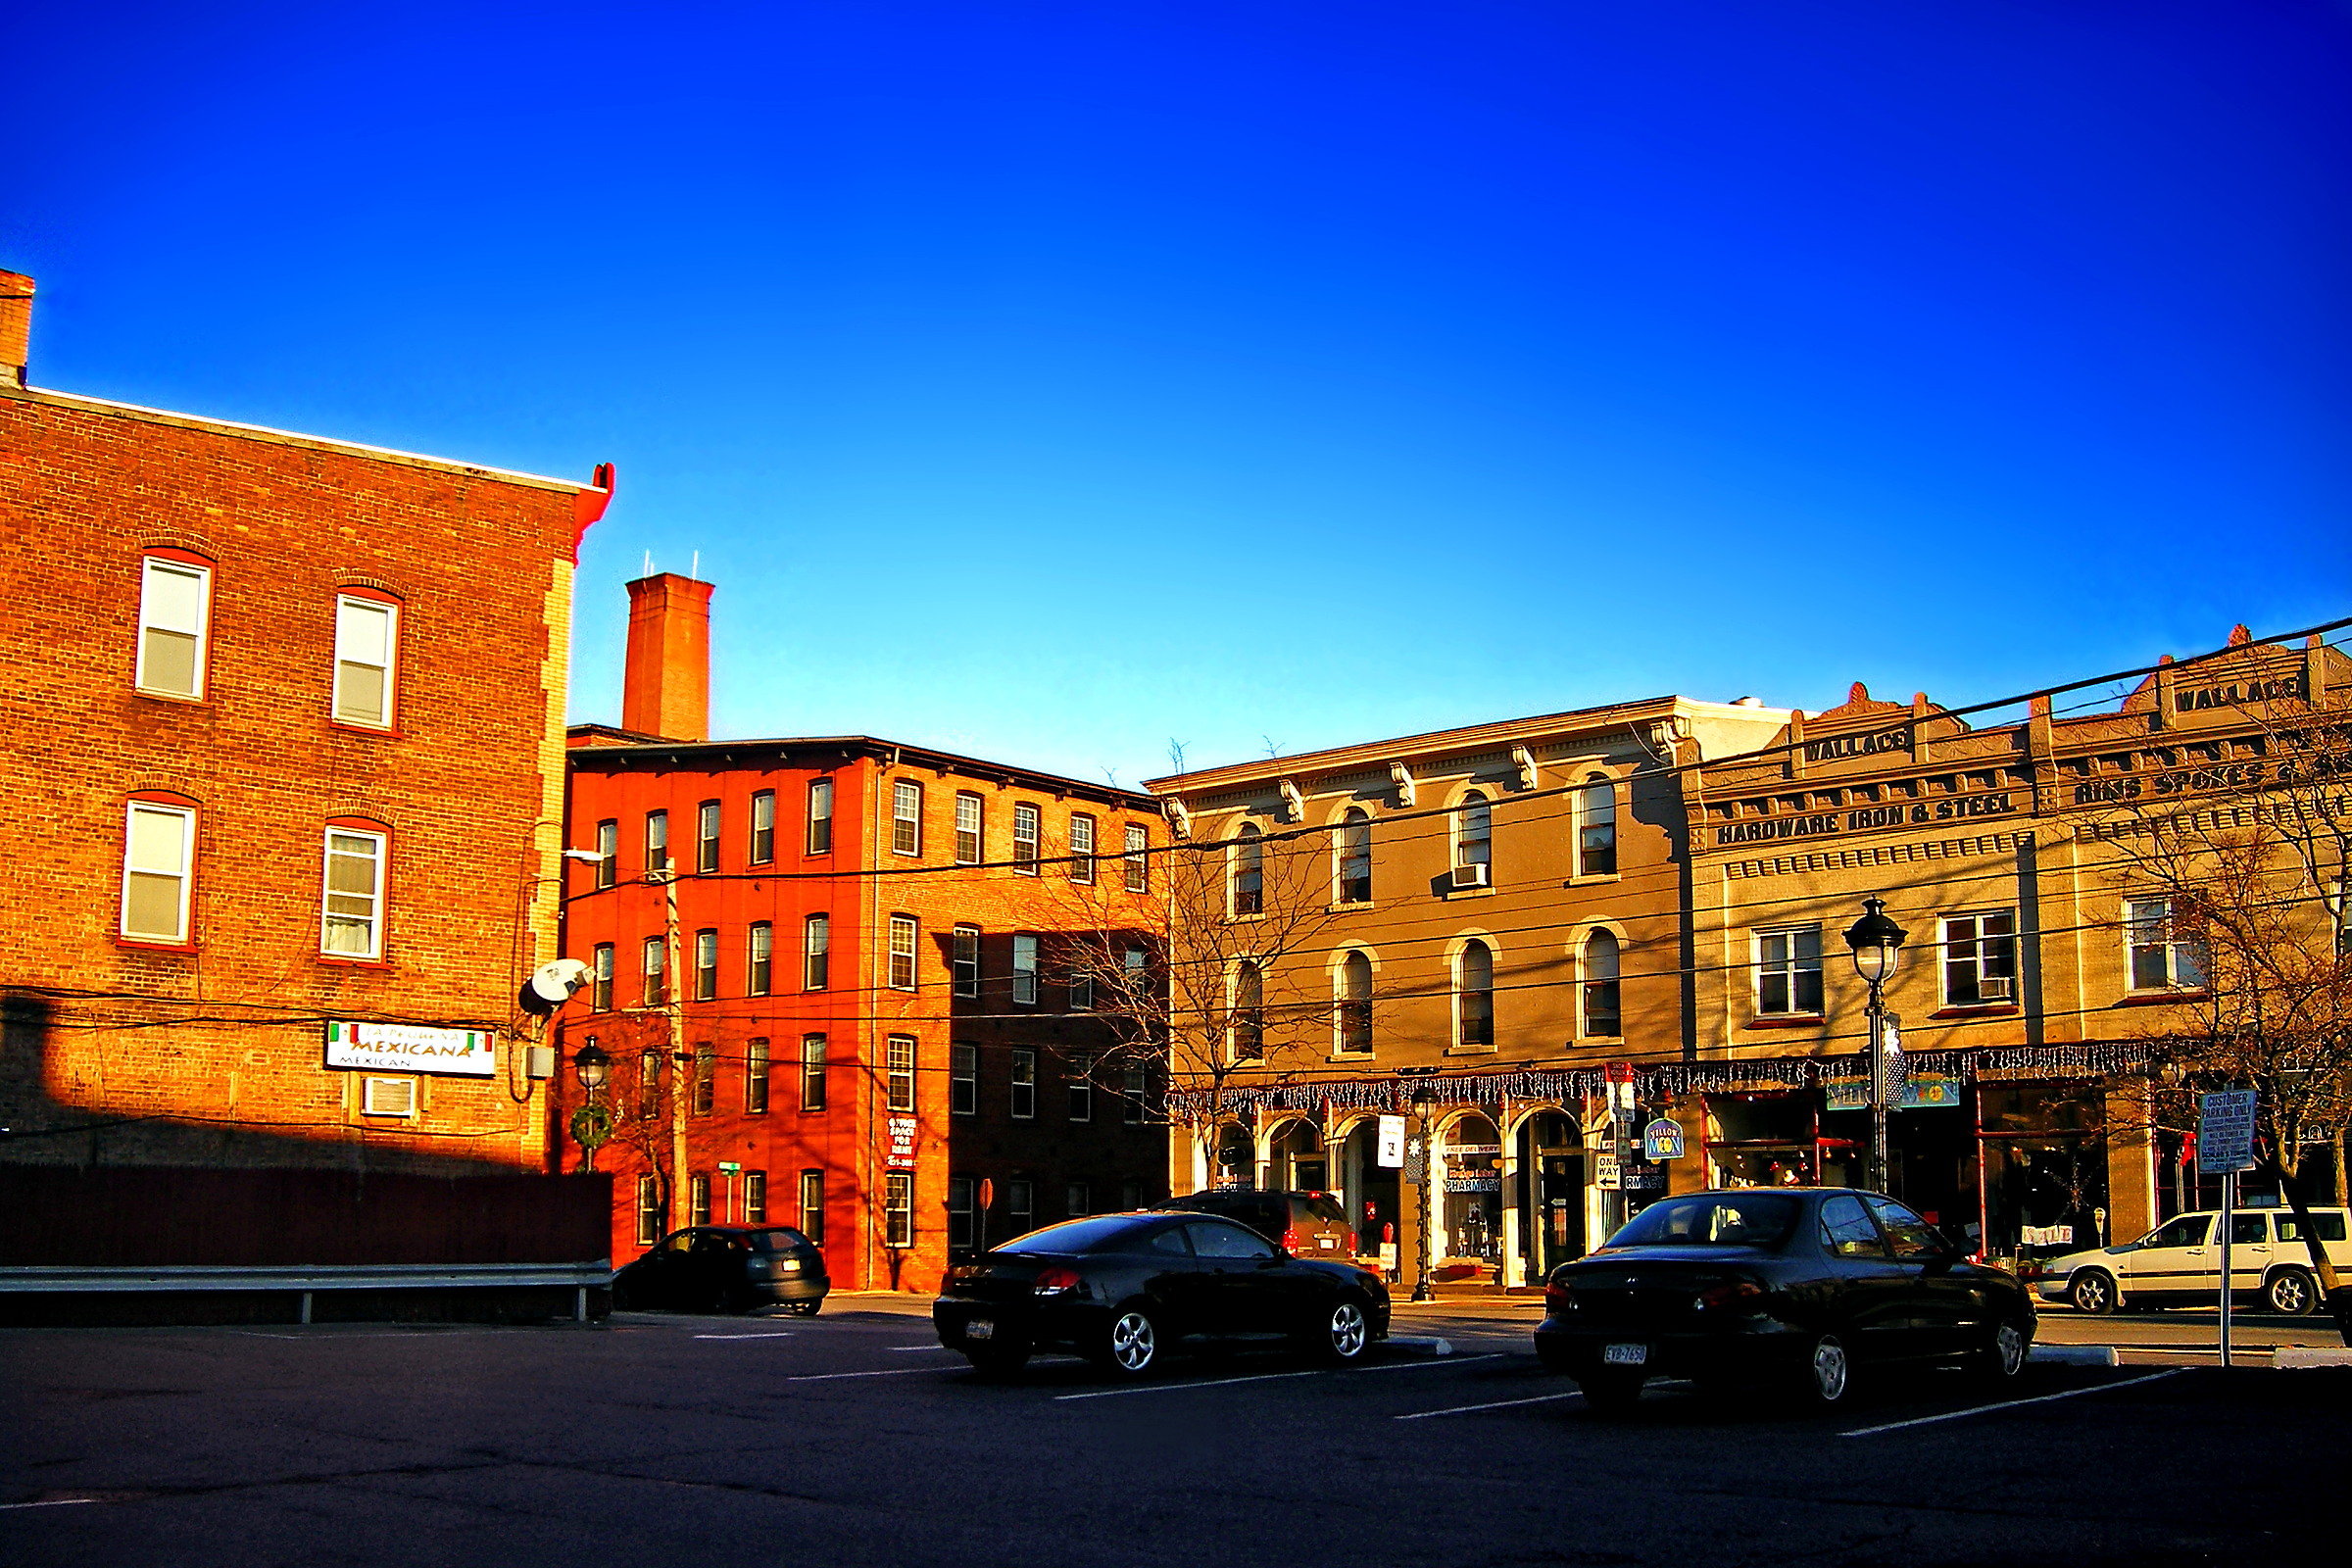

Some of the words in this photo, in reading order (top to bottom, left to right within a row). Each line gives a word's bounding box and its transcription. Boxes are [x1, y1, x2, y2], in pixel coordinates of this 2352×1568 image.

[2176, 678, 2299, 712] WALLACE
[1804, 730, 1911, 761] WALLACE
[1717, 812, 1841, 845] HARDWARE
[1847, 805, 1906, 831] IRON
[1911, 804, 1931, 823] &
[1936, 793, 2019, 819] STEEL
[351, 1041, 471, 1058] MEXICANA
[339, 1056, 411, 1067] MEXICAN
[2207, 1092, 2248, 1107] CUSTOMER
[2202, 1105, 2233, 1118] PARKING
[2234, 1103, 2252, 1116] ONLY
[894, 1136, 910, 1145] FOR
[1648, 1136, 1682, 1154] MOON
[891, 1145, 912, 1154] RENT
[1598, 1167, 1619, 1176] WAY
[1446, 1179, 1501, 1193] PHARMACY
[1626, 1176, 1665, 1190] RMACY
[2024, 1227, 2072, 1244] SALE
